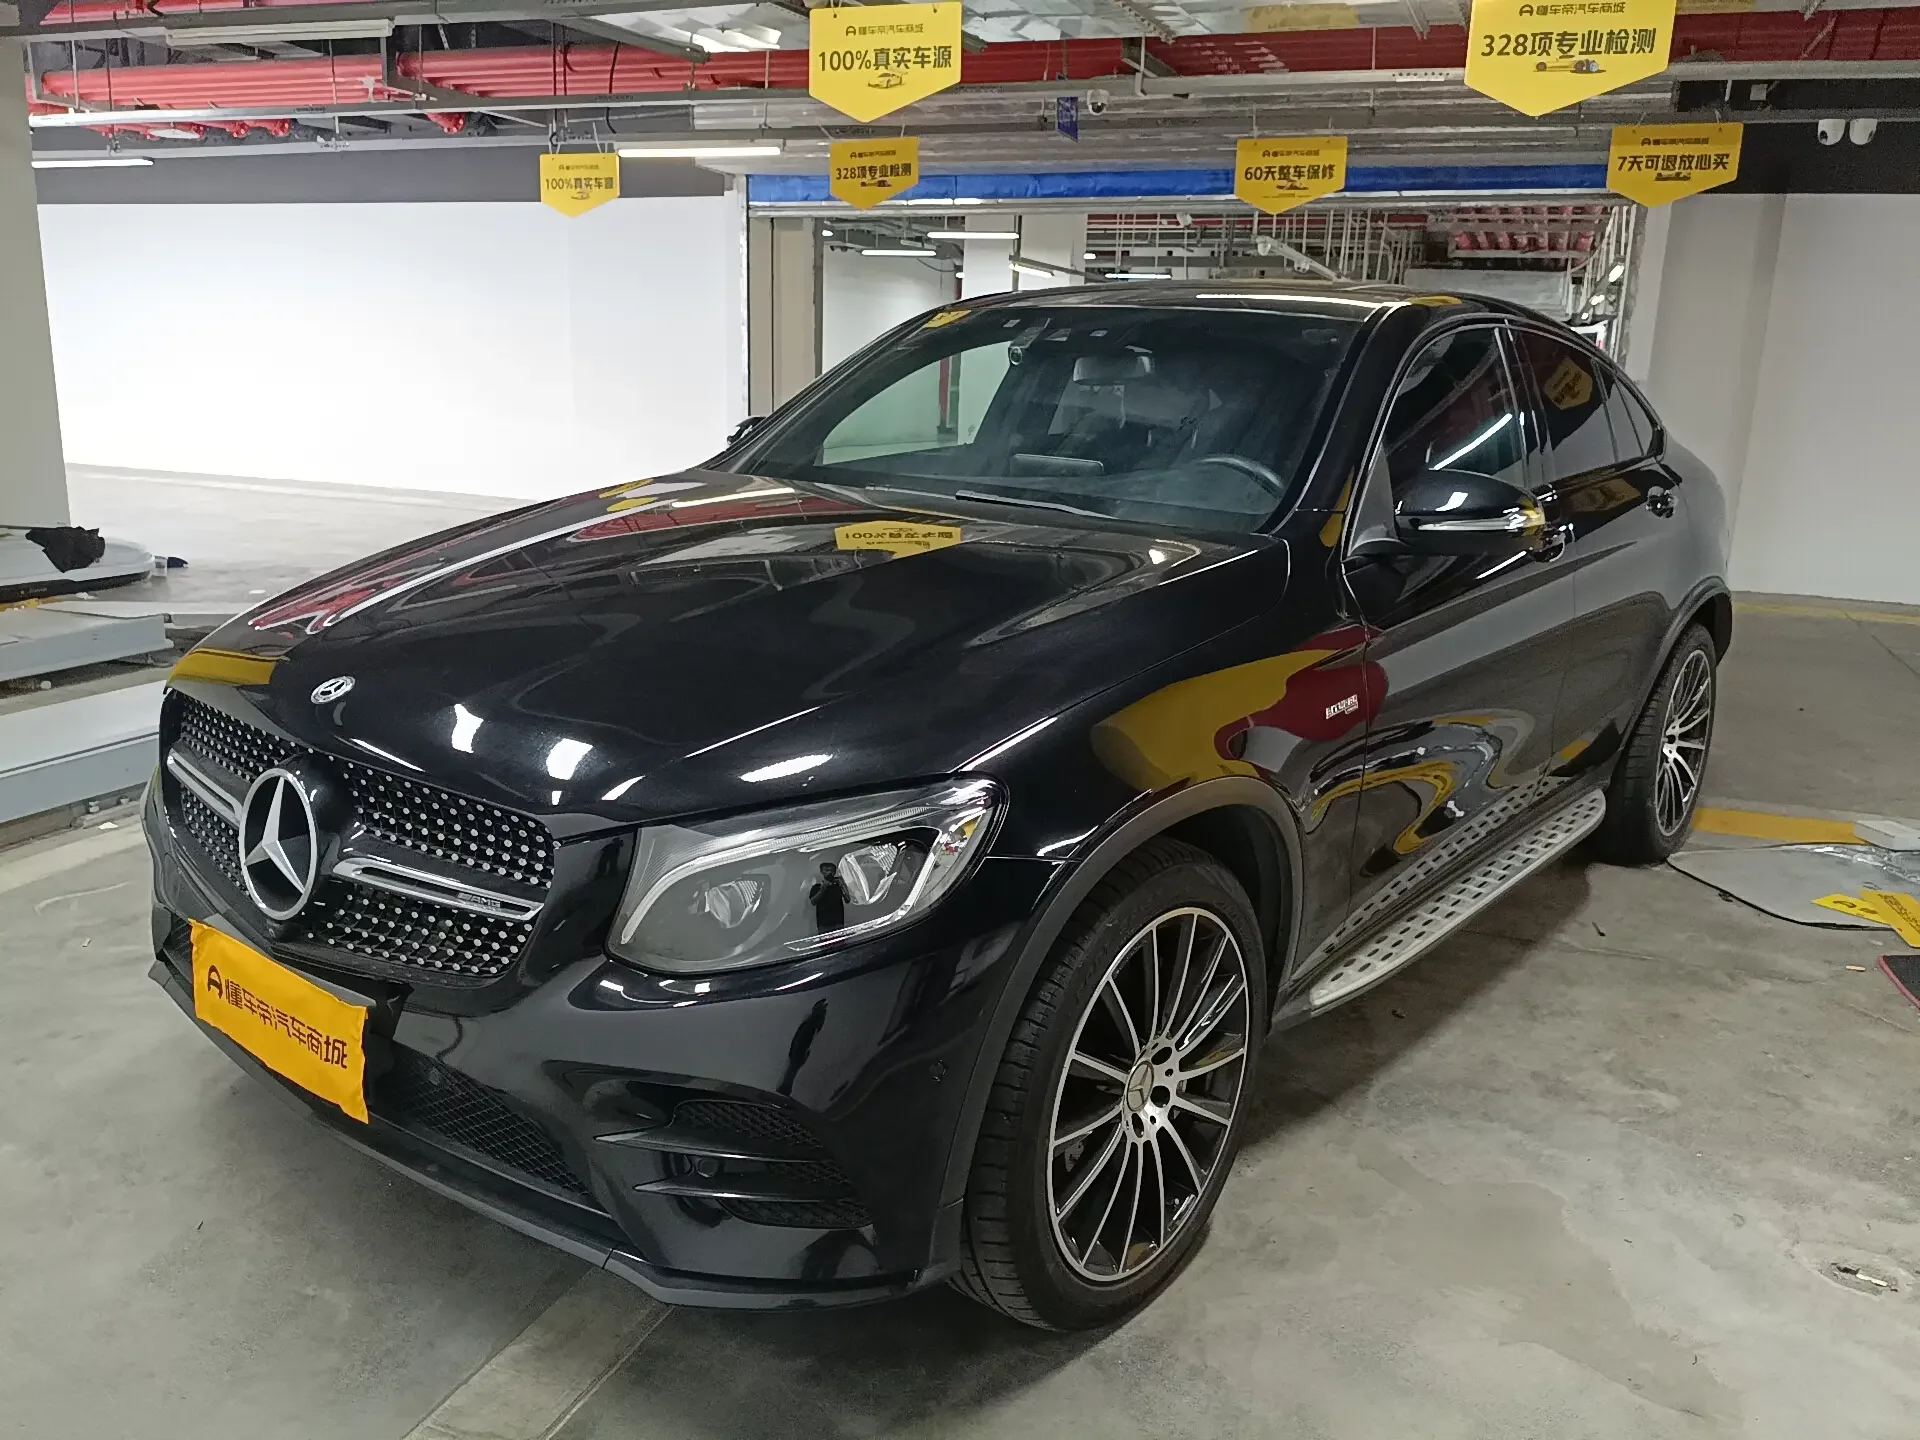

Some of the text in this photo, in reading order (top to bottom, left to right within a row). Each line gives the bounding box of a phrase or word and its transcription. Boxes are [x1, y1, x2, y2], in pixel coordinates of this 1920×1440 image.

[1481, 28, 1657, 59] 328项专业检测
[818, 45, 952, 72] 100%真实车源
[1244, 163, 1336, 181] 60天整车保修
[1617, 153, 1730, 172] 7天可退放心买
[224, 978, 348, 1070] 懂车帝汽车商城
